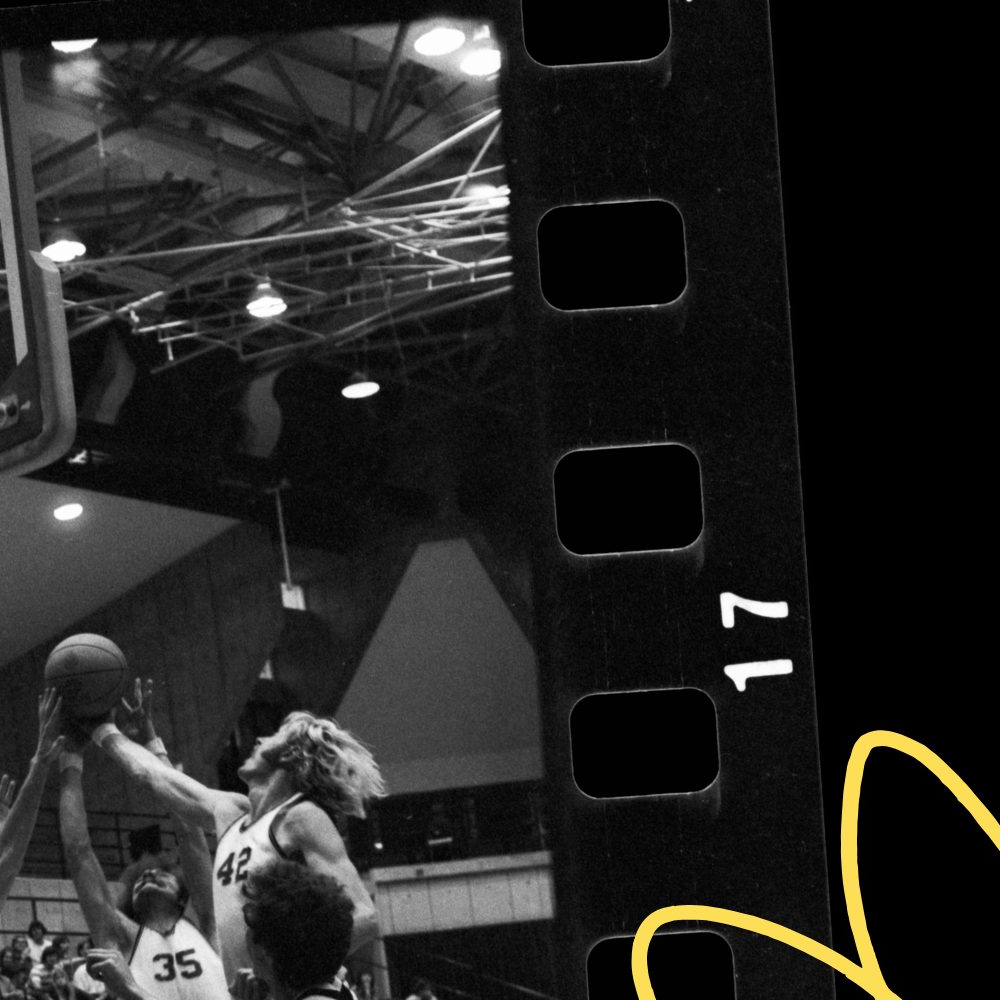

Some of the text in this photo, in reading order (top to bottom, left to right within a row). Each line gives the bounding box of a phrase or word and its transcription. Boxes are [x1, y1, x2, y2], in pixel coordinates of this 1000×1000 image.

[719, 591, 794, 693] 17
[216, 846, 252, 886] 42
[152, 948, 204, 983] 35
